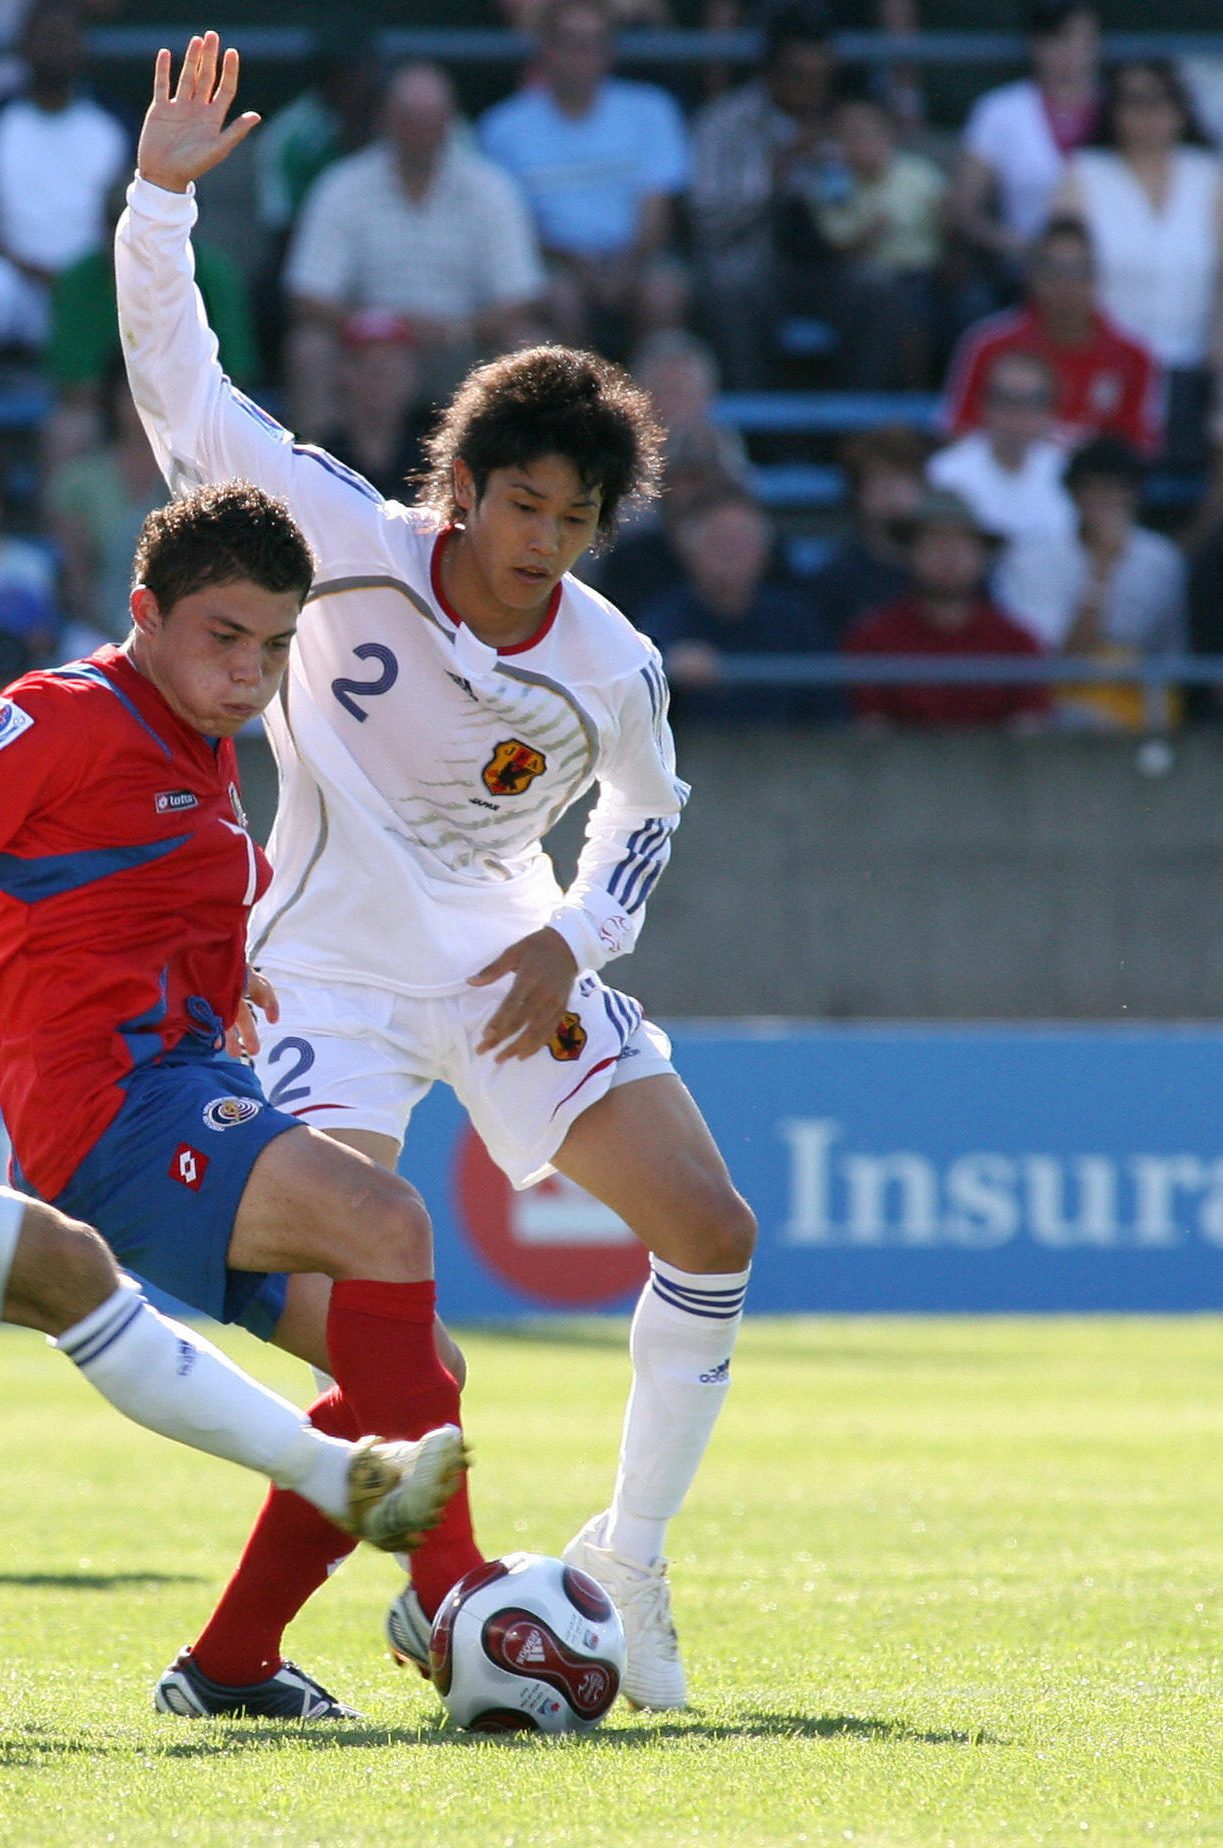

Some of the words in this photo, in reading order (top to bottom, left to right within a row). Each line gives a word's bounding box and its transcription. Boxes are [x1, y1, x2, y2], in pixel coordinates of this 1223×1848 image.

[331, 643, 398, 723] 2
[170, 794, 193, 806] lotto
[267, 1036, 315, 1107] 2
[779, 1116, 1223, 1249] Insur
